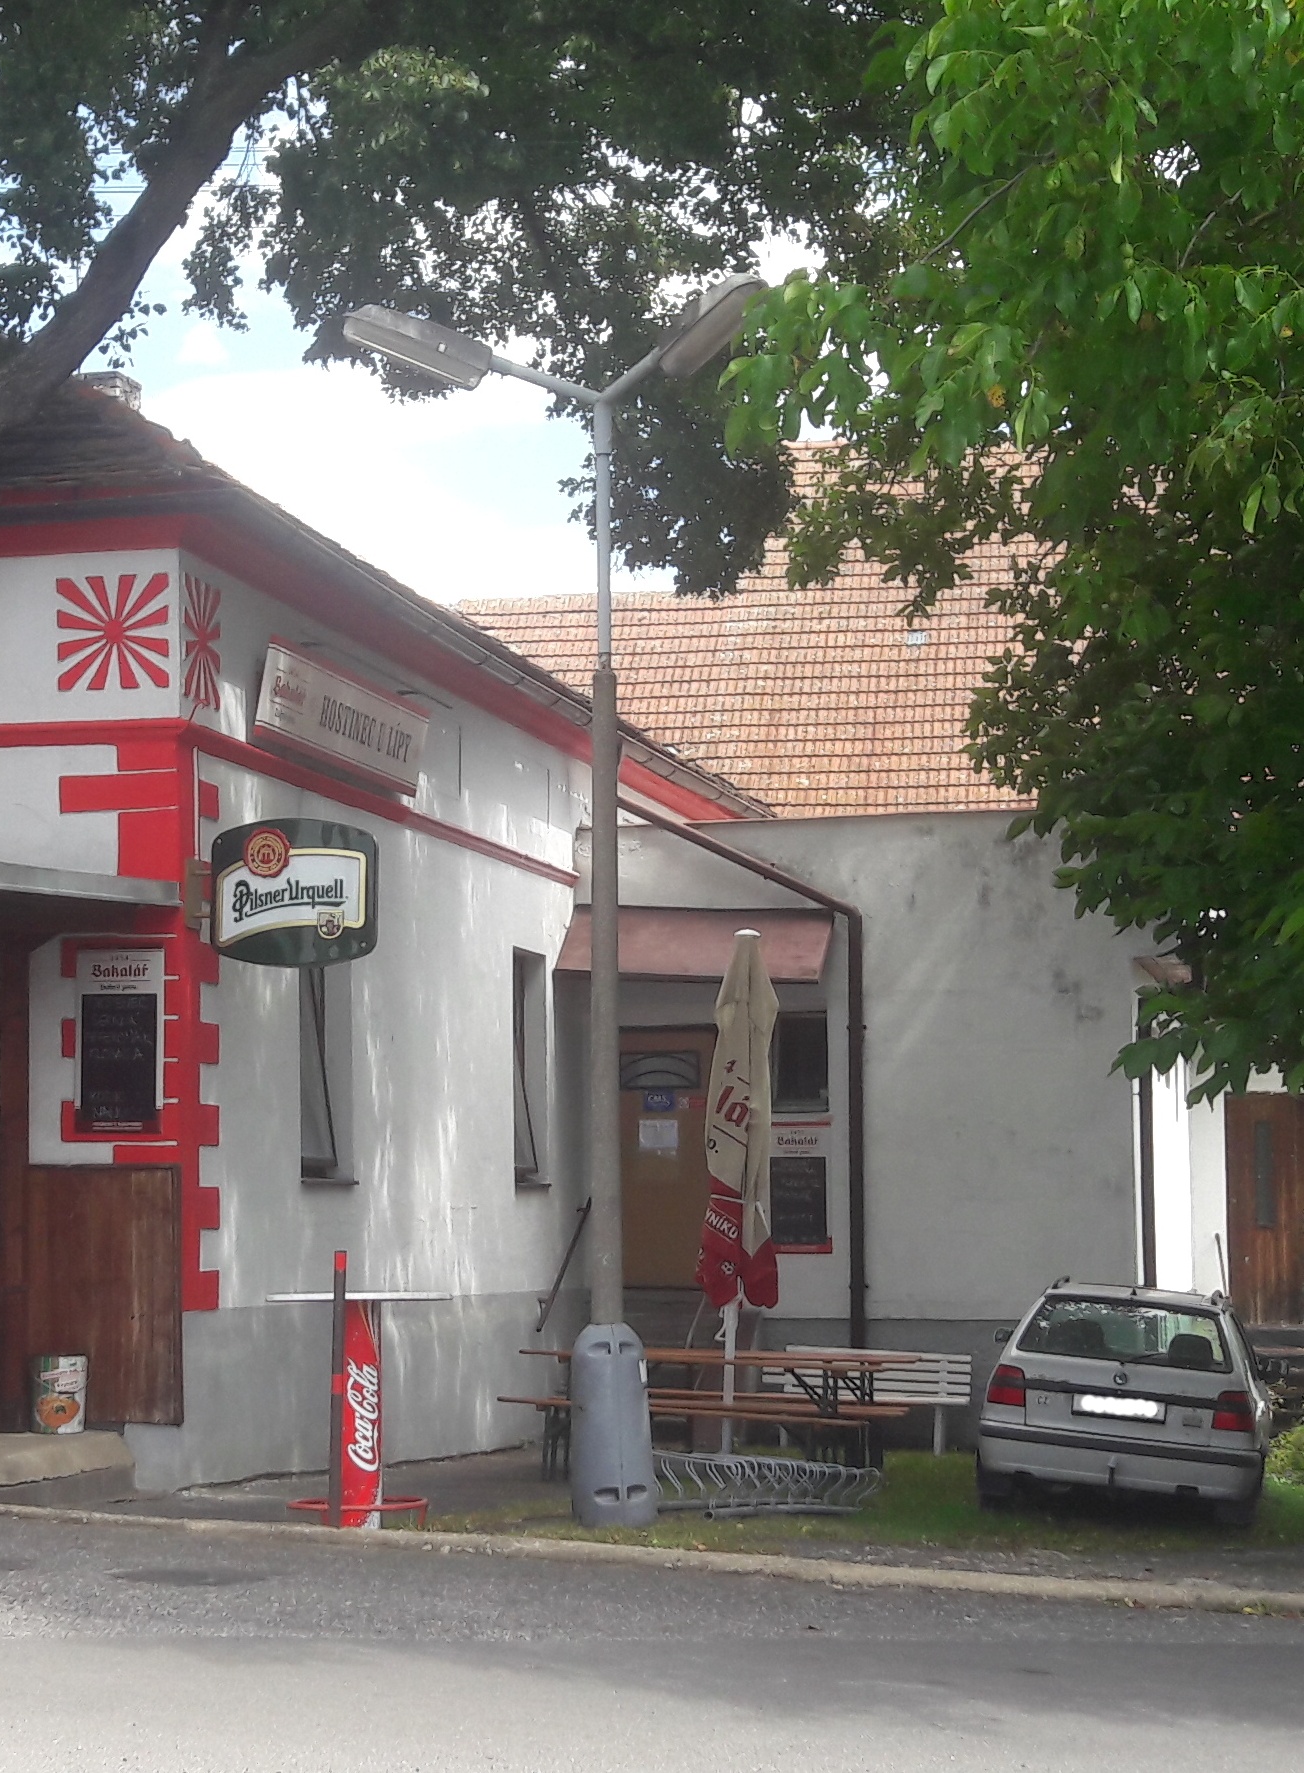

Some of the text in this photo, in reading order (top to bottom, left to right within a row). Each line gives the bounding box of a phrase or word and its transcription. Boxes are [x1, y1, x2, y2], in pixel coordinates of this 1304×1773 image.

[319, 695, 376, 748] HOSTINEC
[386, 722, 413, 763] LÍPY
[232, 877, 344, 923] Pilsner Urquell
[91, 964, 149, 978] Bakalář
